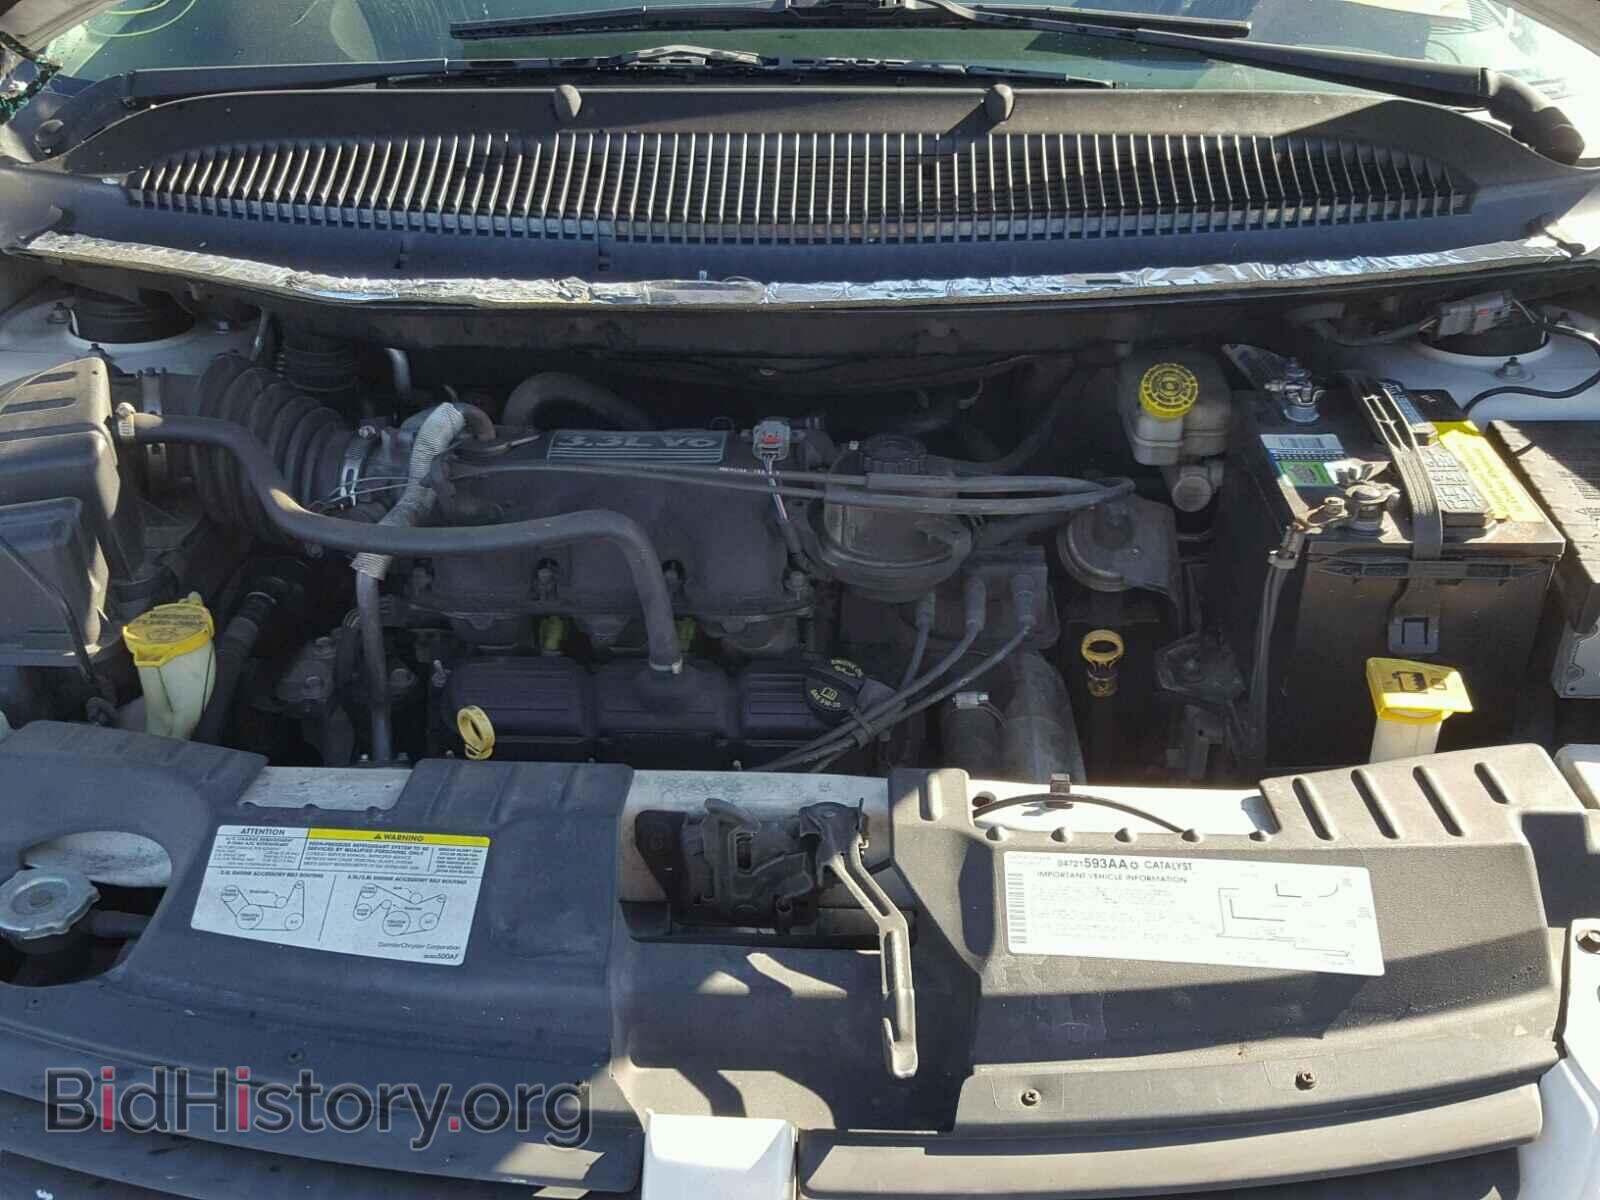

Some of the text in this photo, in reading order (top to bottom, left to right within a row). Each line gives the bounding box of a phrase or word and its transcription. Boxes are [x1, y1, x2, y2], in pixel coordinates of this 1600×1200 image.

[557, 434, 717, 449] 3.3L V6
[240, 827, 286, 836] ATTENTION
[383, 833, 425, 842] WARNING
[1144, 859, 1193, 871] CATALYST
[1037, 871, 1188, 883] IMPORTANT VEHICLE INFORMATION
